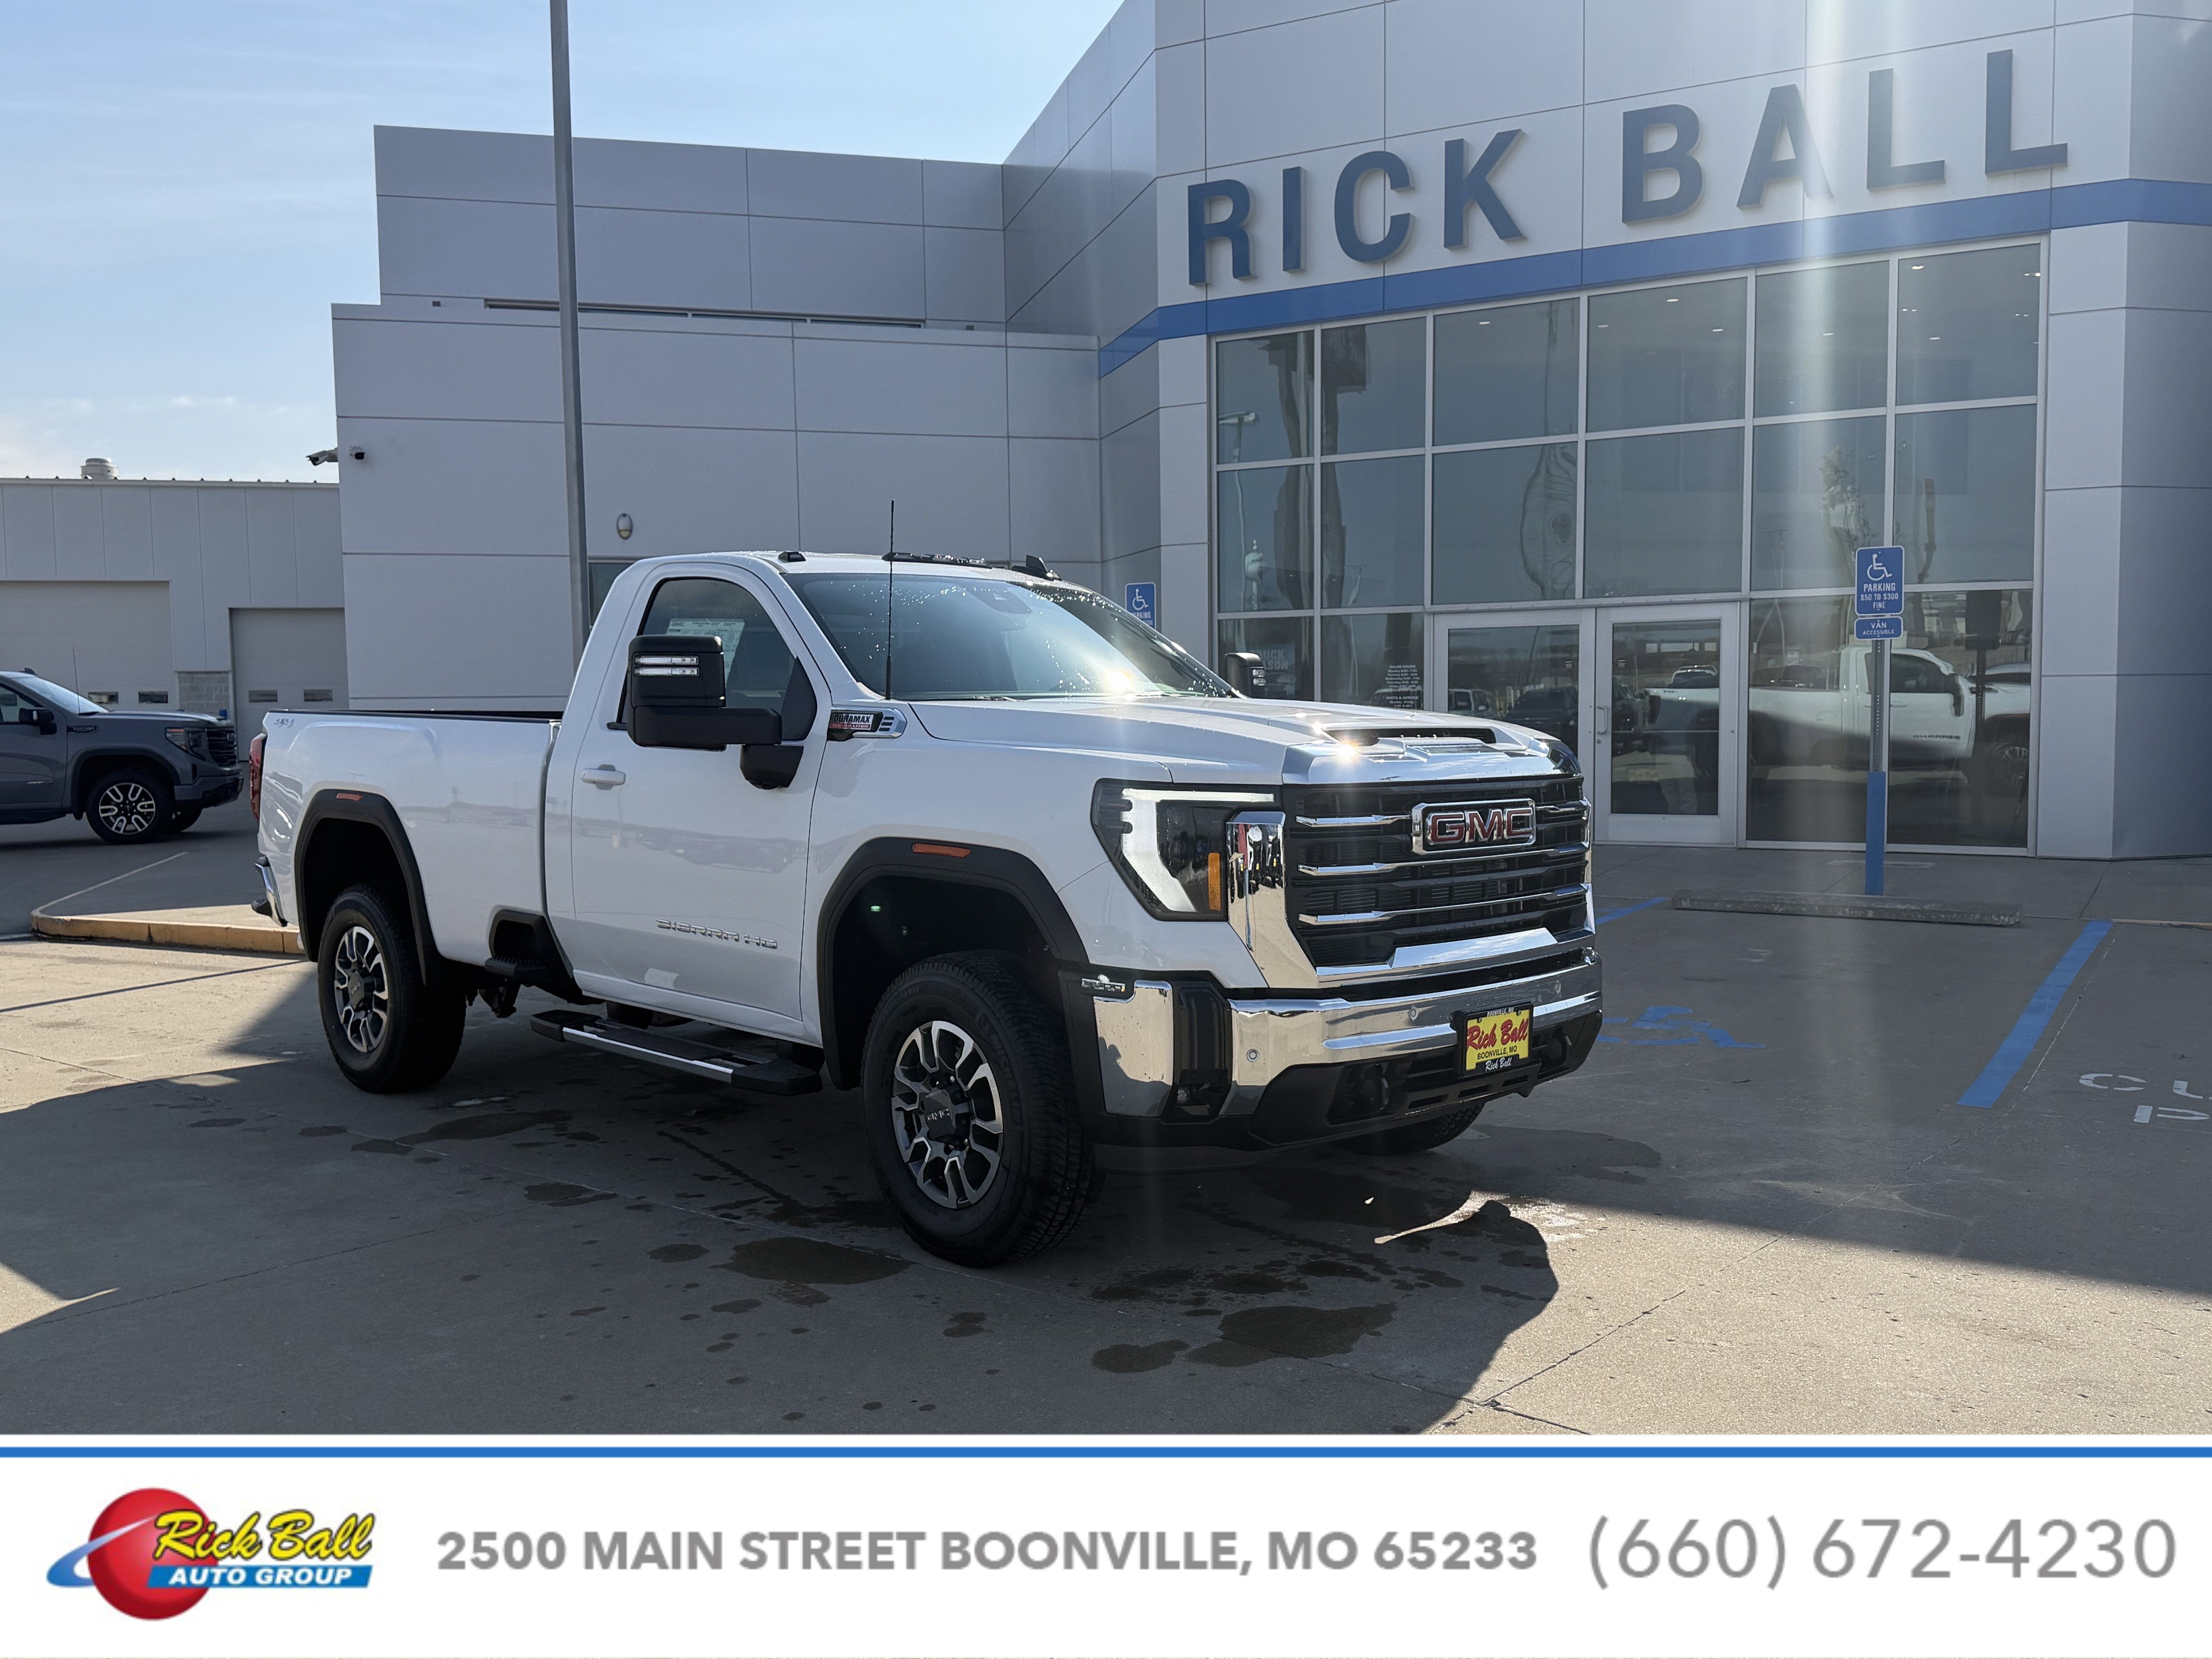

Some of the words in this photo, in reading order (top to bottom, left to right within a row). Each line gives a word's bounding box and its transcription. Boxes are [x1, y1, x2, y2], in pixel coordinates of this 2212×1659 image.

[1188, 129, 1527, 287] RICK
[1622, 49, 2068, 225] BALL
[1863, 582, 1896, 592] PARKING
[833, 714, 871, 723] DURAMAX
[1426, 807, 1533, 845] GMC
[656, 919, 739, 942] SIERRA
[744, 934, 778, 949] HD
[1467, 1023, 1497, 1051] Rick
[1500, 1017, 1529, 1045] Ball
[1477, 1047, 1508, 1060] BOONVILLE,
[1485, 1059, 1499, 1072] Rick
[1499, 1057, 1512, 1068] Ball
